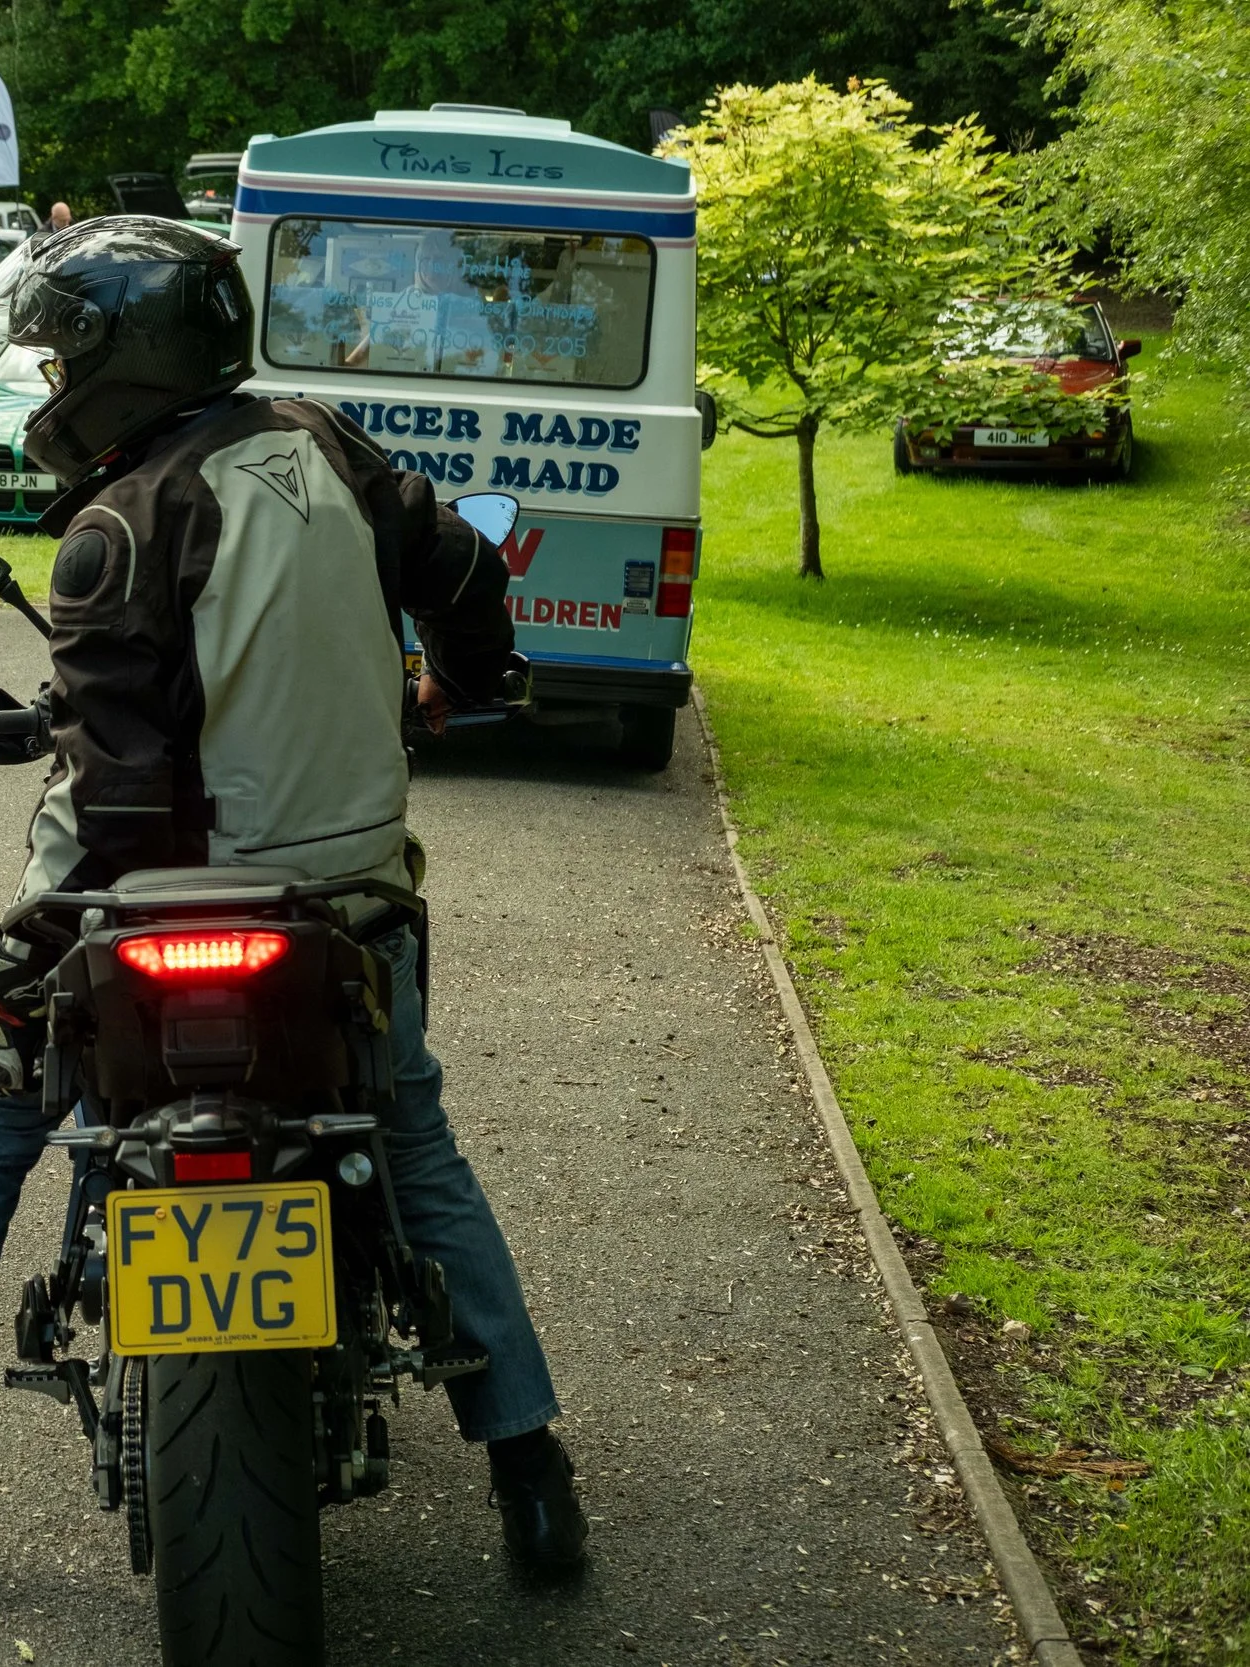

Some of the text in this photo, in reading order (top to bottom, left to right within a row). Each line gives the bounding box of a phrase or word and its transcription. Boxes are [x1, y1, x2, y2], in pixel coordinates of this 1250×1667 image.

[543, 334, 587, 358] 205
[501, 411, 642, 453] MADE
[987, 431, 1007, 444] 410
[487, 455, 620, 497] MAID
[120, 1198, 318, 1266] FY75
[148, 1270, 295, 1335] DVG
